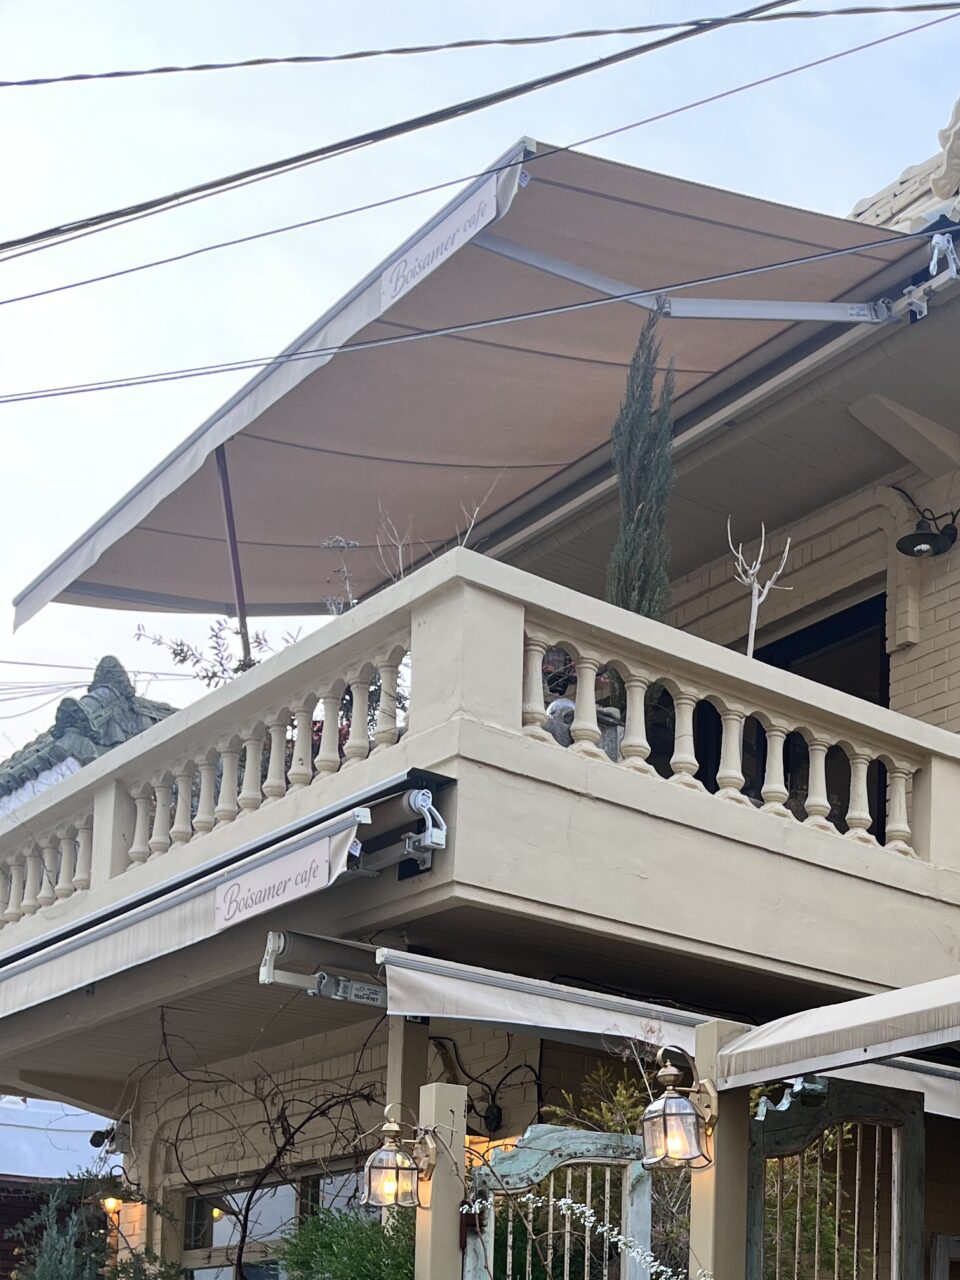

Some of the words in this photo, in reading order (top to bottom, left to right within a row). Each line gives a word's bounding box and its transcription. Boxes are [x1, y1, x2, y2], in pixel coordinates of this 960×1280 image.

[389, 228, 460, 300] Boisamer
[463, 200, 487, 233] cafe
[224, 878, 292, 922] Boisamer
[295, 859, 319, 888] cafe
